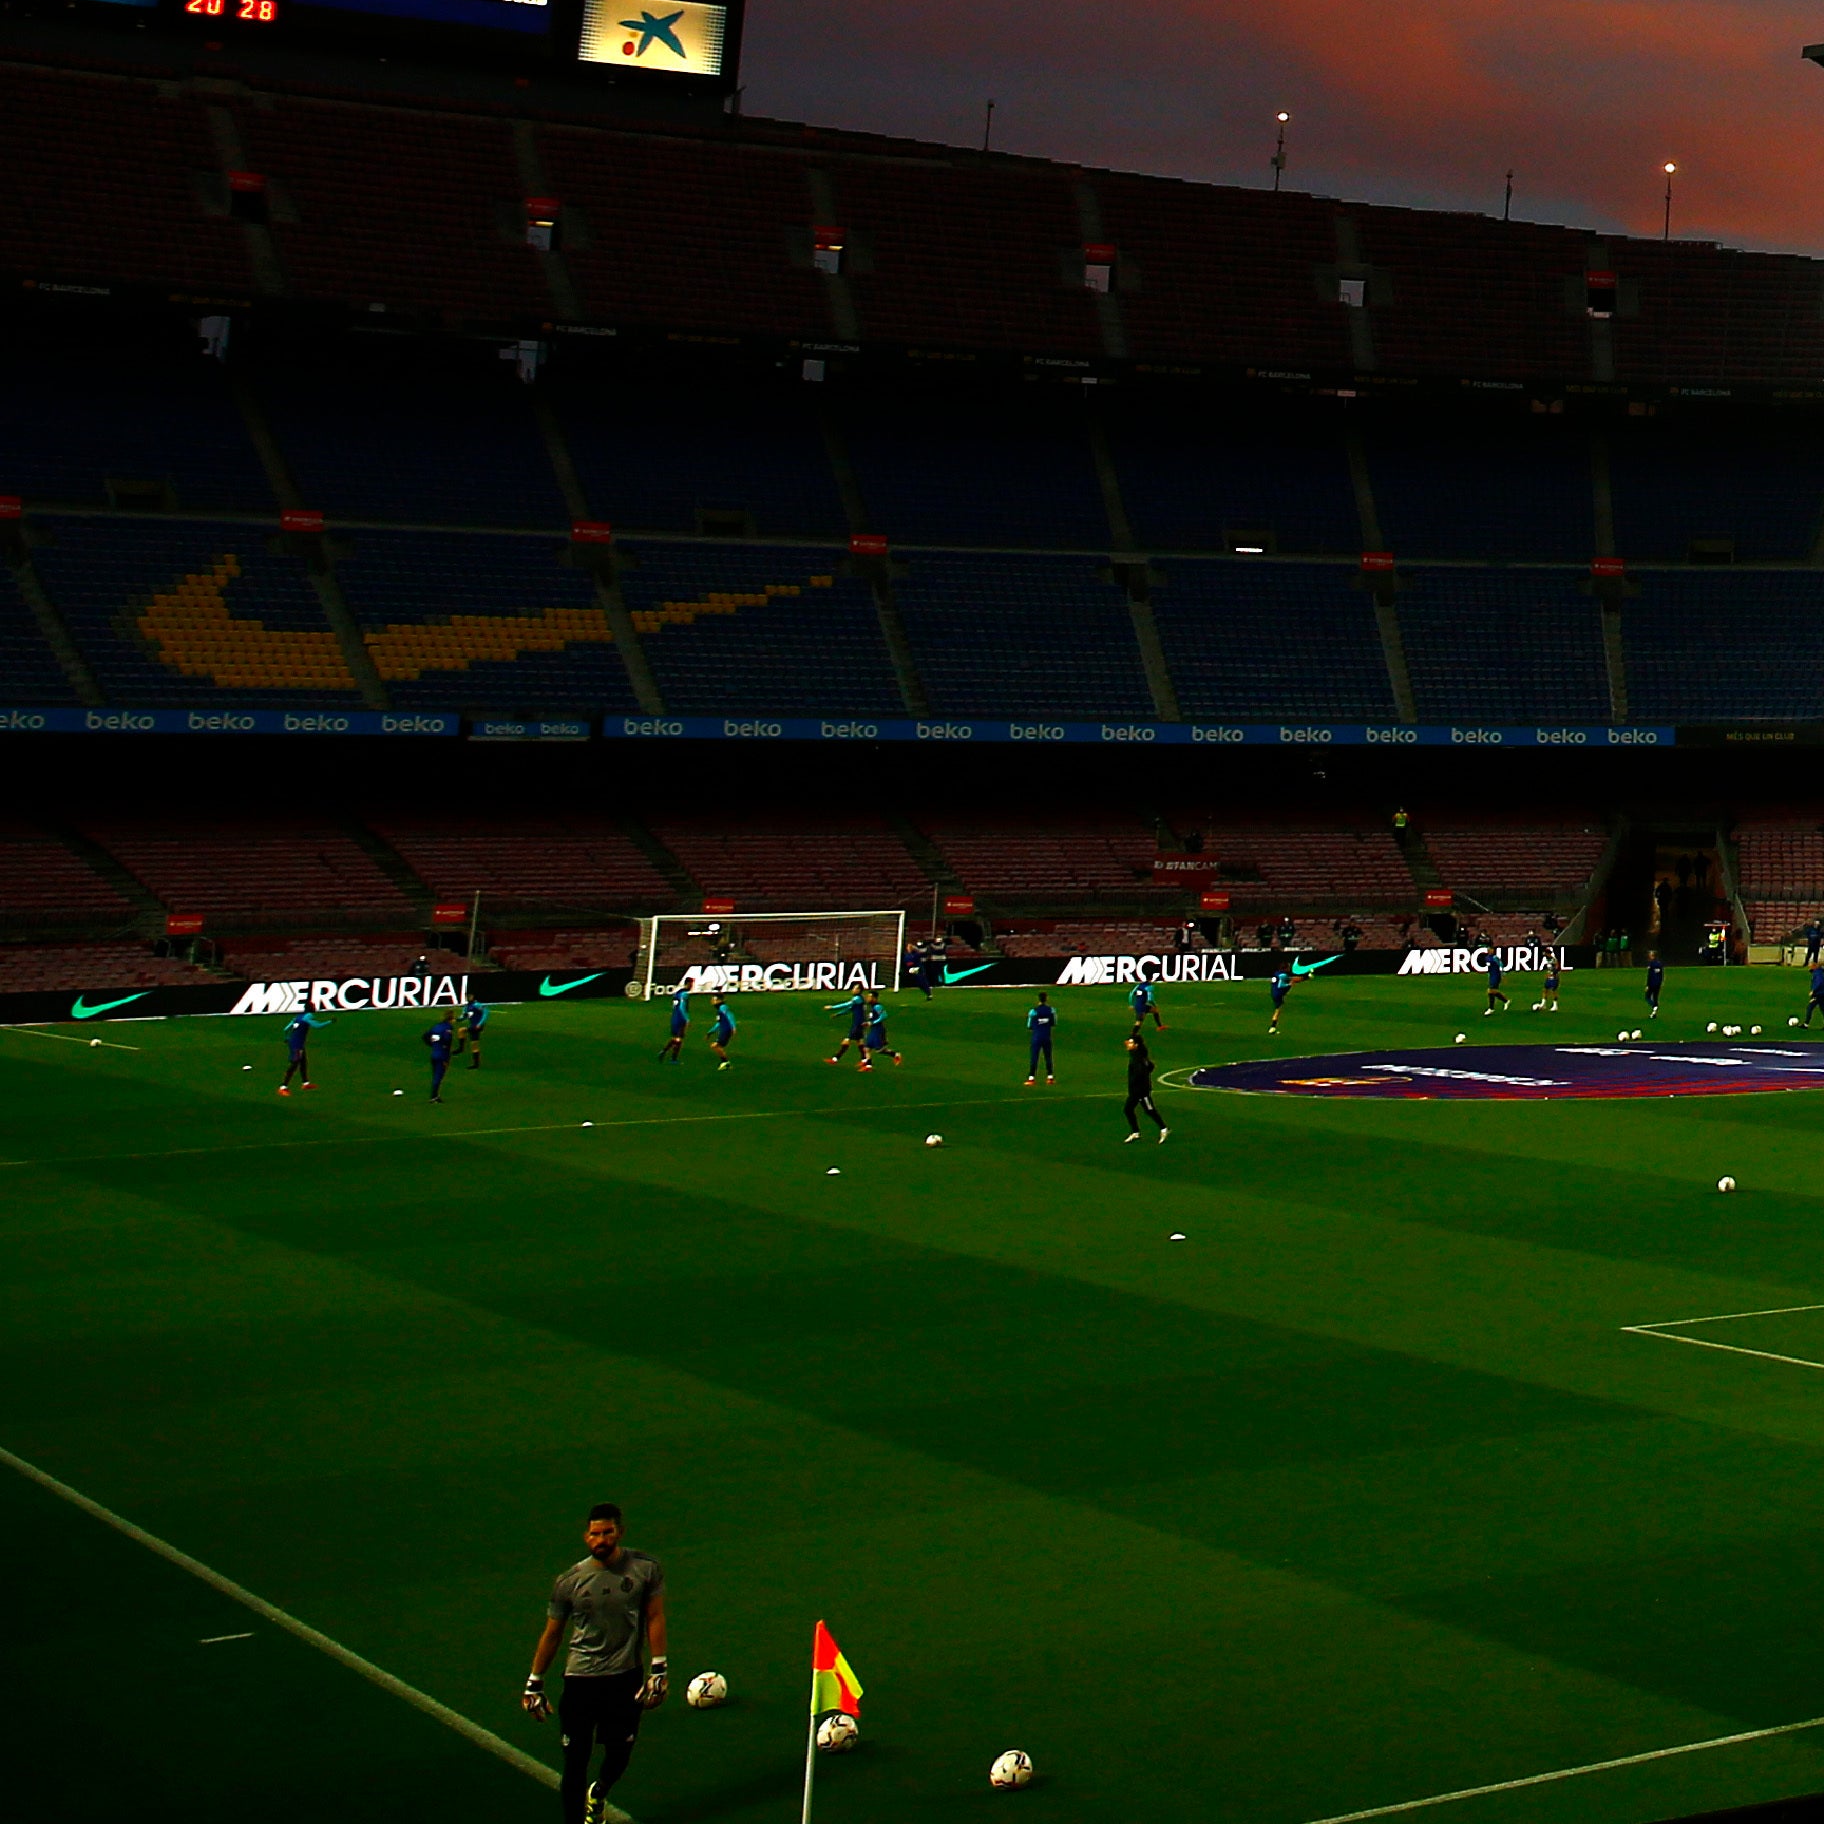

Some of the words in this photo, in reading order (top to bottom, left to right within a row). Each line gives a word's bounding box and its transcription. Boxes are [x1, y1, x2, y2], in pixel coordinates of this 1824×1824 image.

[0, 711, 45, 730] eko
[85, 711, 155, 730] beko
[188, 713, 255, 731] beko
[283, 713, 348, 731] beko
[381, 715, 444, 732] beko
[485, 721, 525, 735] beko
[540, 721, 579, 735] beko
[623, 719, 683, 736] beko
[723, 720, 782, 737] beko
[821, 721, 878, 737] beko
[916, 722, 972, 740] beko
[1009, 723, 1065, 740] beko
[1101, 724, 1155, 741] beko
[1191, 725, 1244, 742] beko
[1280, 726, 1332, 743] beko
[1365, 726, 1418, 743] beko
[1450, 727, 1502, 743] beko
[1536, 727, 1586, 744] beko
[1607, 728, 1657, 744] beko
[1398, 946, 1573, 974] MERCURIAL
[679, 961, 886, 995] MERCURIAL
[1056, 954, 1243, 985] MERCURIAL
